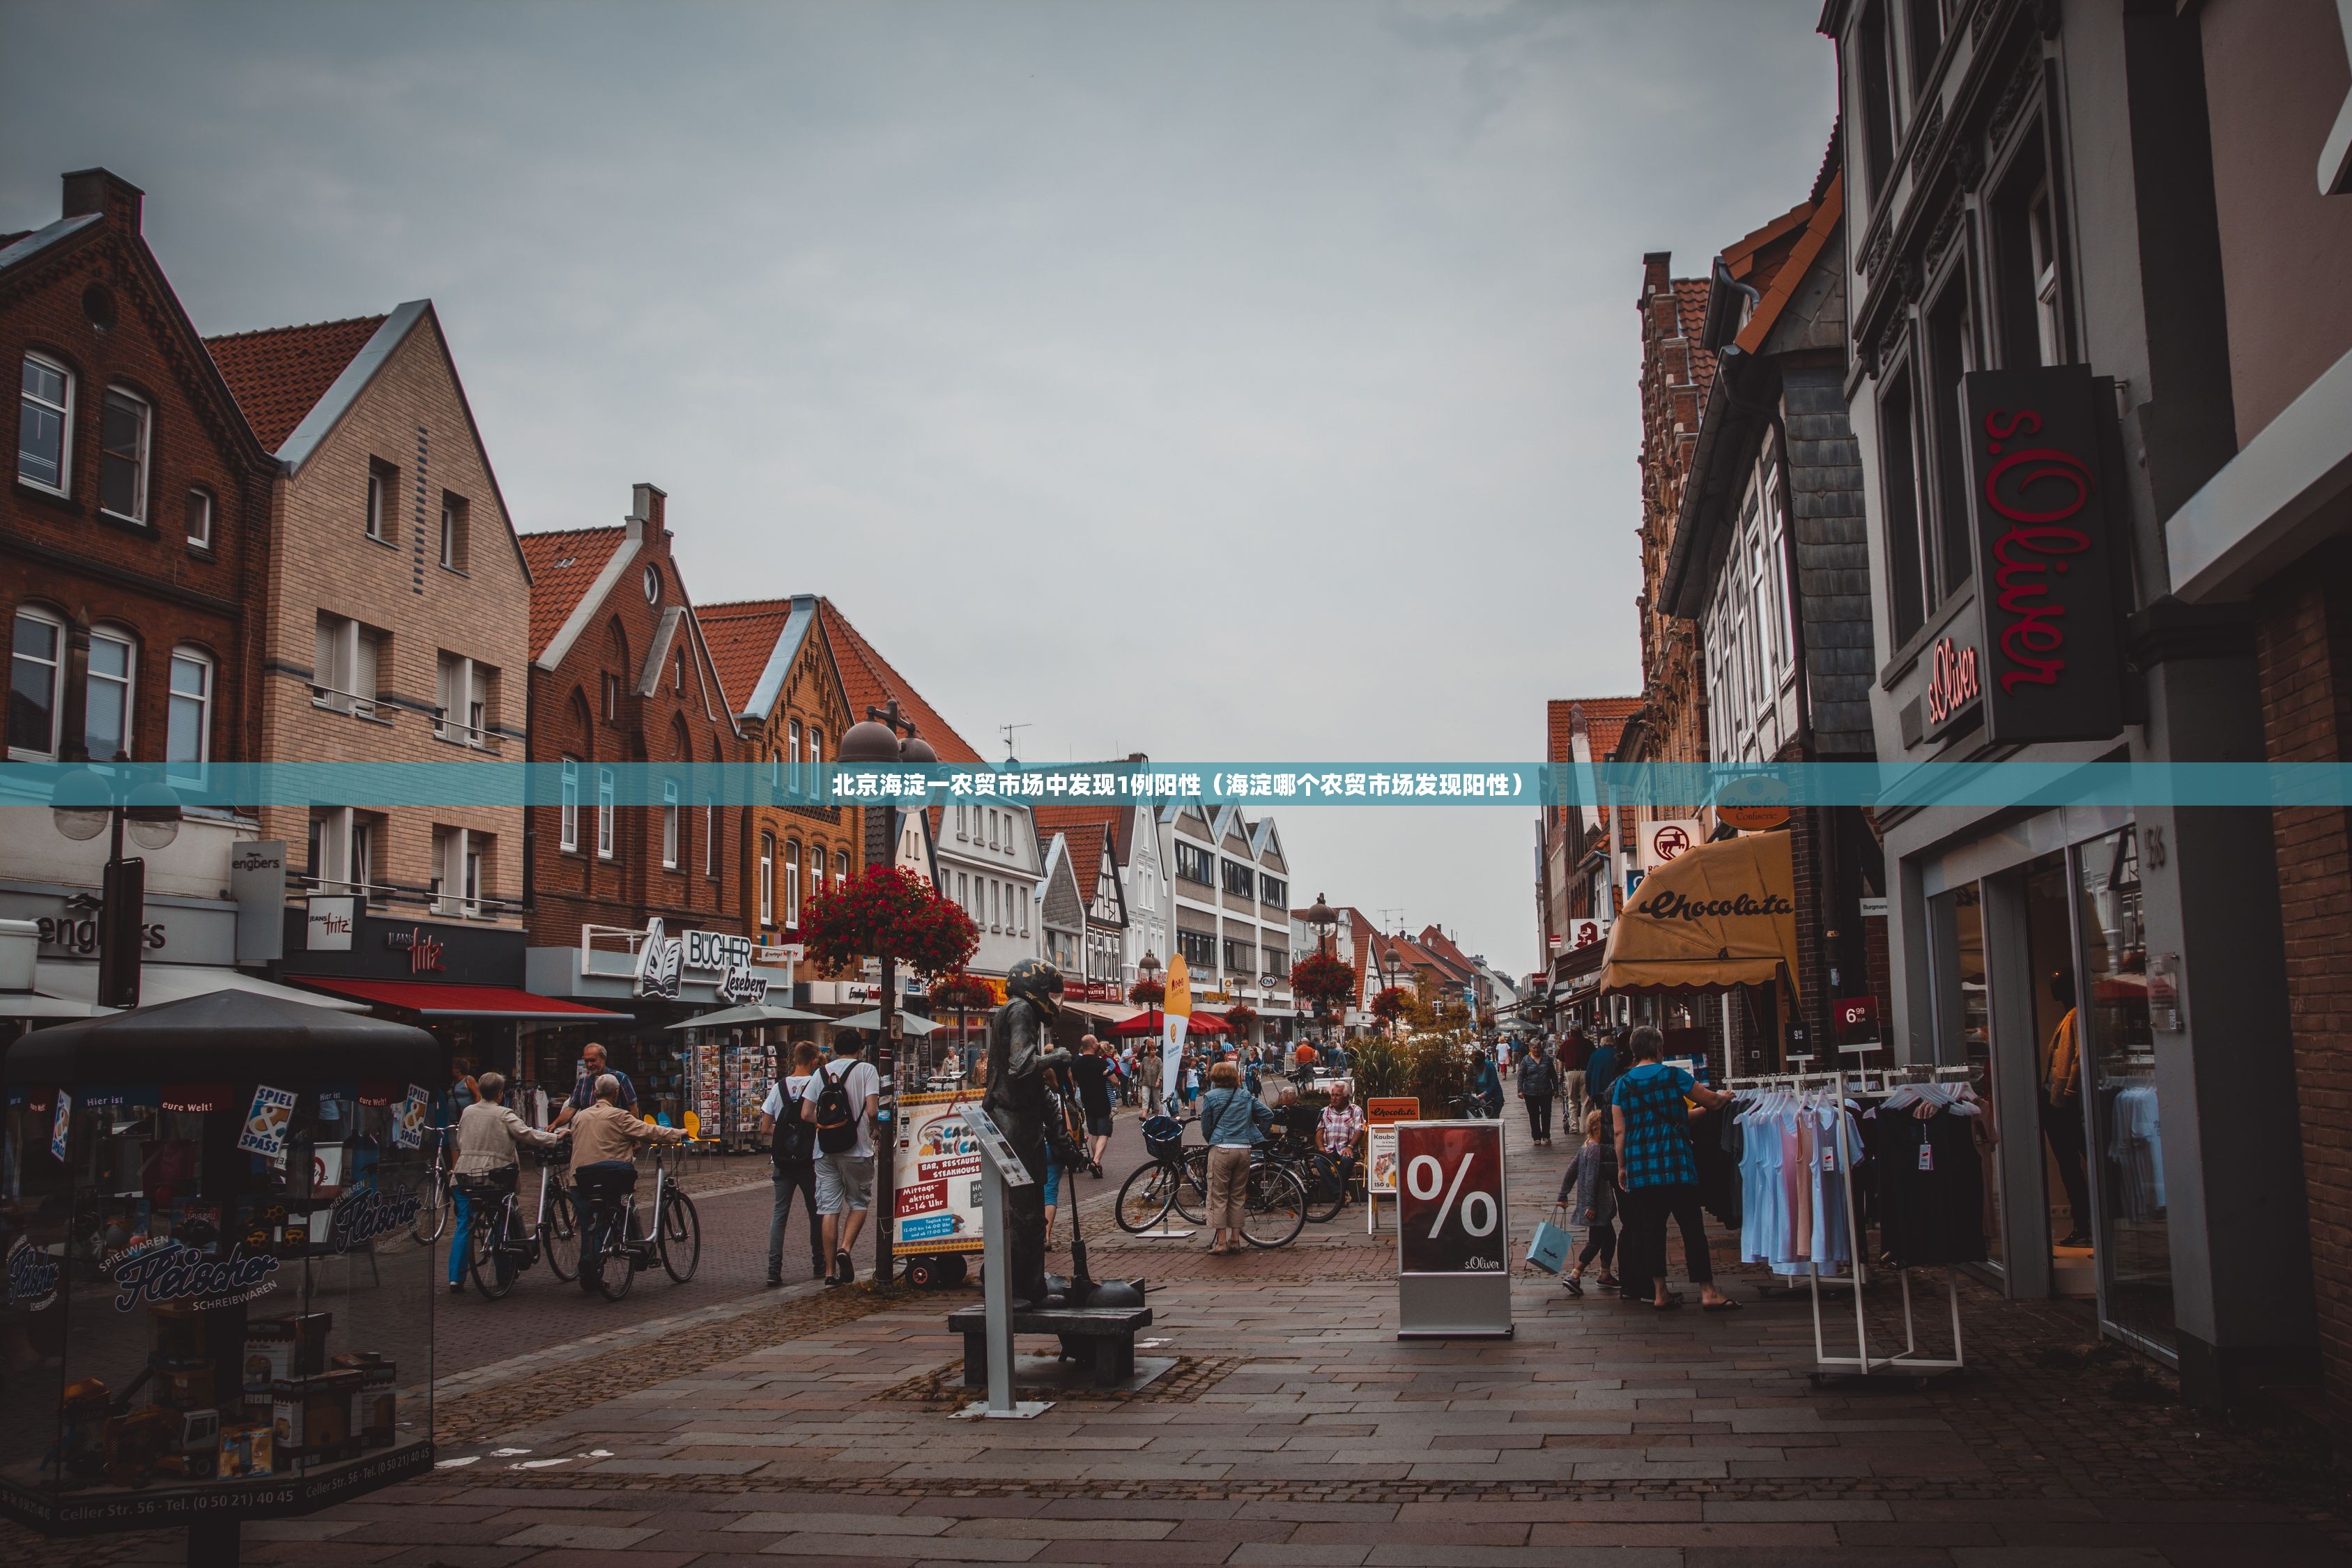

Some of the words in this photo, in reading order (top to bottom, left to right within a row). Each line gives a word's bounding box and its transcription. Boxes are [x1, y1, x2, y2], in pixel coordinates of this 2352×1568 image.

[1985, 409, 2096, 696] s.Oliver
[1928, 637, 1981, 725] s.Oliver
[1736, 811, 1777, 821] Confiserie
[232, 856, 280, 871] engbers
[1638, 891, 1794, 921] Chocolata
[323, 912, 352, 936] fritz
[38, 917, 165, 955] engrs
[690, 932, 751, 968] BÜCHER
[724, 966, 767, 1000] Leseberg
[87, 1097, 107, 1106] Hier
[111, 1096, 123, 1105] ist
[257, 1088, 293, 1107] SPIEL
[319, 1092, 332, 1100] Hier
[359, 1096, 371, 1105] eure
[373, 1097, 387, 1106] Welt!
[409, 1086, 427, 1102] SPIEL
[162, 1101, 185, 1112] eure
[187, 1102, 213, 1112] Welt!
[1371, 1107, 1416, 1117] Chocolata
[241, 1133, 279, 1153] SPASS
[401, 1130, 420, 1146] SPASS
[921, 1162, 939, 1171] BAR,
[932, 1165, 980, 1178] STEAKHOUSE
[330, 1180, 365, 1209] PIELWAREN
[902, 1184, 939, 1196] Mittags-
[909, 1194, 935, 1204] aktion
[902, 1203, 925, 1213] 12-14
[98, 1235, 170, 1273] SPIELWAREN
[1465, 1255, 1500, 1270] s.Oliver
[114, 1241, 279, 1313] Fleischer
[192, 1279, 278, 1312] SCHREIBWAREN
[306, 1482, 330, 1498] Celler
[332, 1477, 346, 1490] Str.
[348, 1473, 358, 1485] 56
[363, 1466, 376, 1479] Tel.
[387, 1459, 397, 1472] 50
[410, 1450, 420, 1463] 40
[420, 1447, 430, 1460] 45
[60, 1507, 105, 1521] Celler
[107, 1505, 133, 1518] Str.
[137, 1501, 155, 1514] 56
[165, 1498, 190, 1512] Tel.
[193, 1496, 207, 1511] (0
[210, 1495, 228, 1508] 50
[231, 1492, 253, 1507] 21)
[256, 1491, 273, 1504] 40
[277, 1490, 294, 1502] 45
